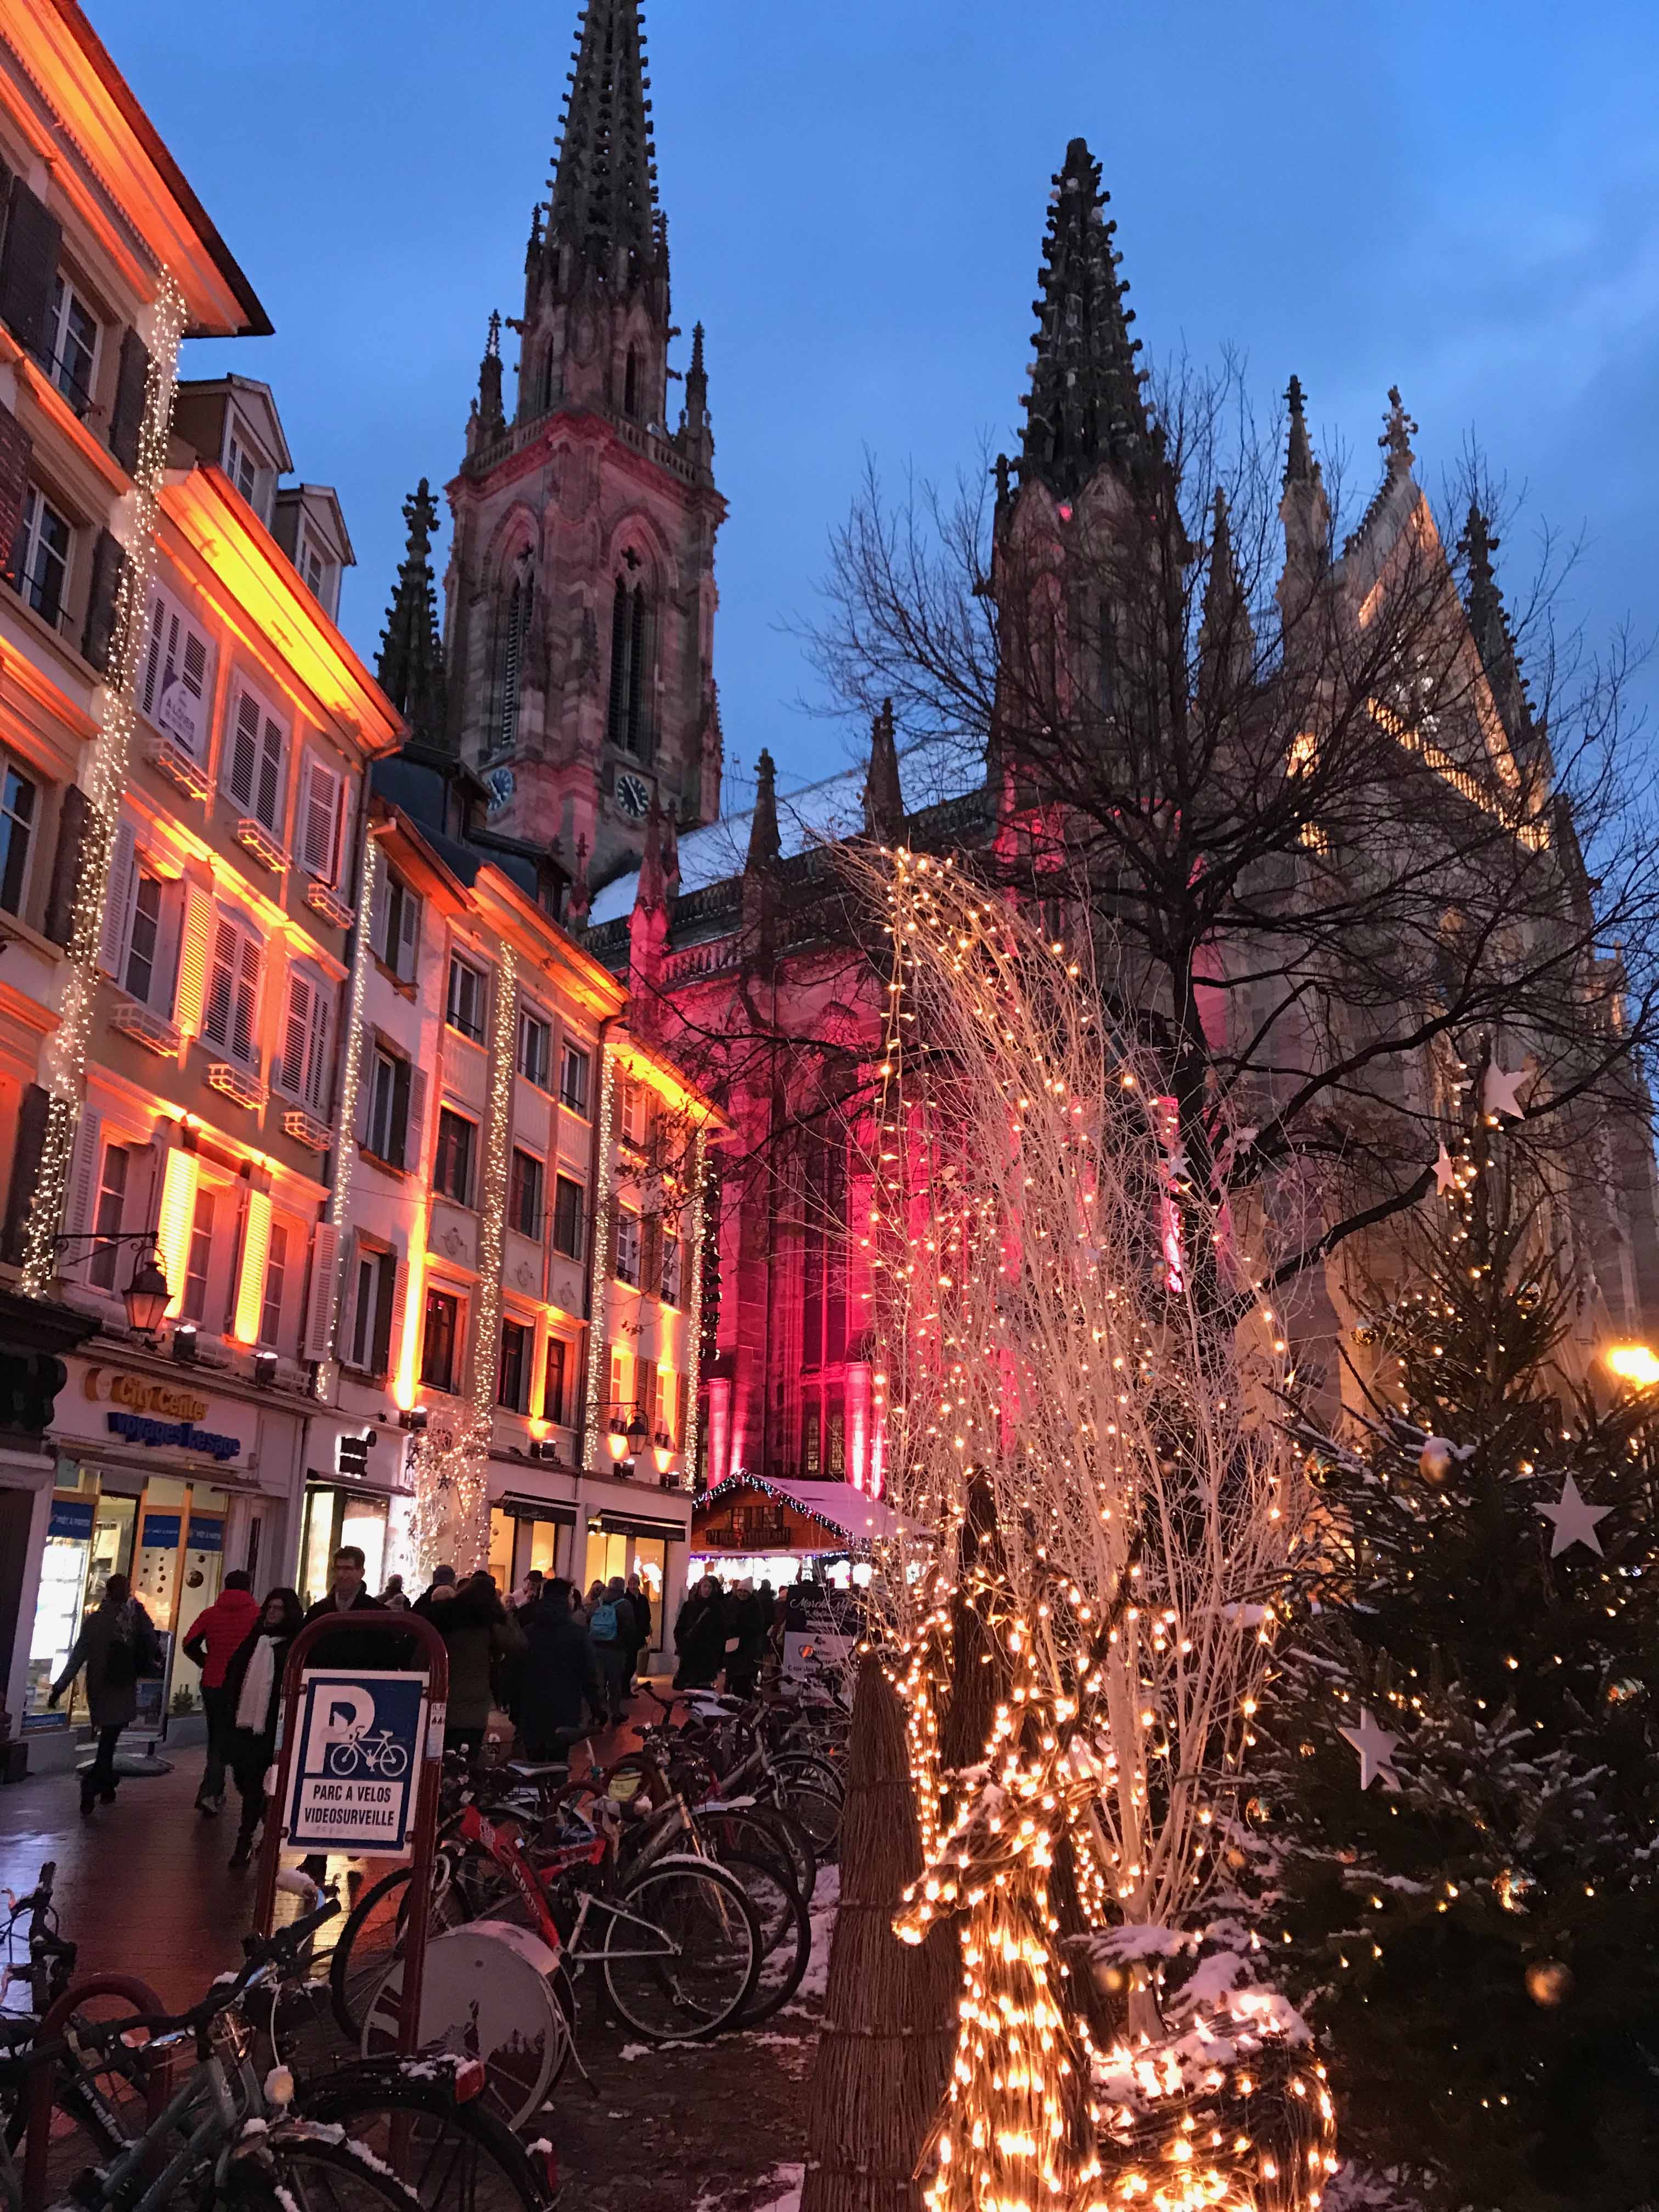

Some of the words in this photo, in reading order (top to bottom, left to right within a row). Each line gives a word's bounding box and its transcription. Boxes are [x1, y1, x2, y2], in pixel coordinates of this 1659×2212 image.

[113, 1376, 151, 1413] City
[154, 1386, 209, 1421] Center
[304, 1685, 375, 1773] P
[313, 1785, 343, 1801] PARC
[345, 1786, 353, 1801] A
[358, 1786, 391, 1803] VELOS
[304, 1807, 395, 1826] VIDEOSURVEILLE
